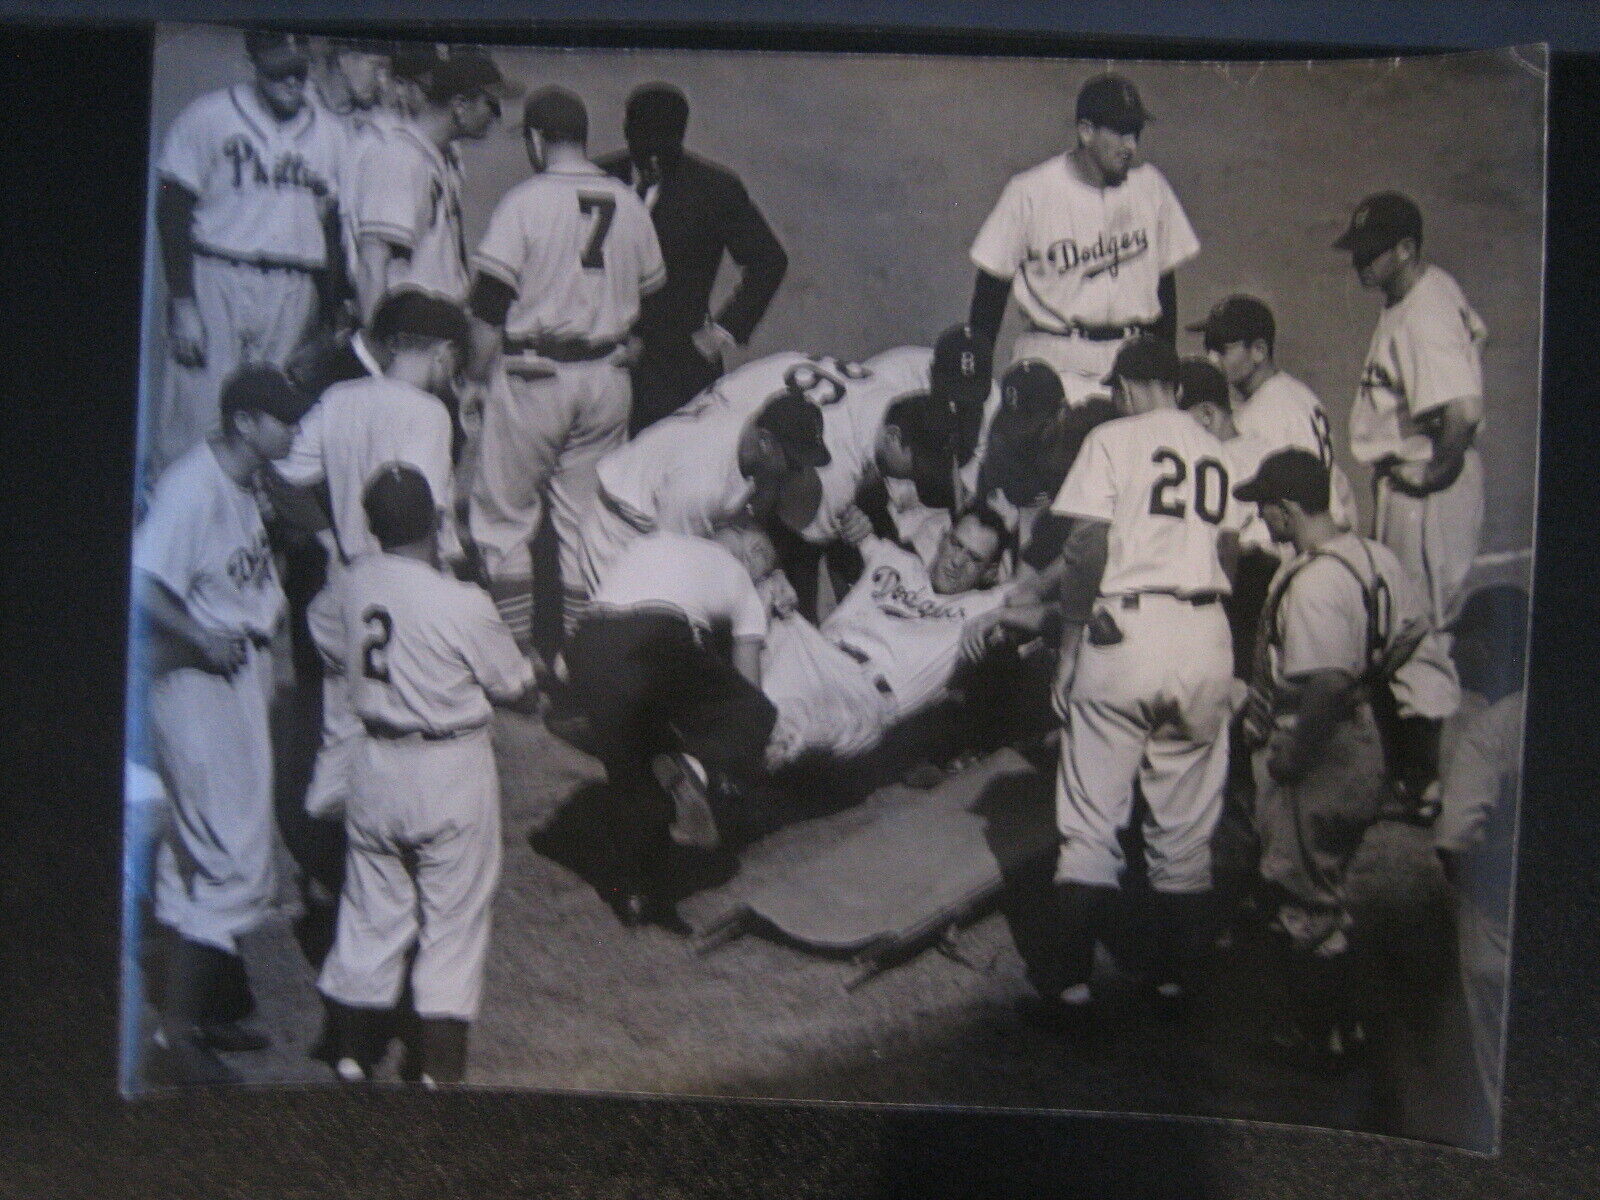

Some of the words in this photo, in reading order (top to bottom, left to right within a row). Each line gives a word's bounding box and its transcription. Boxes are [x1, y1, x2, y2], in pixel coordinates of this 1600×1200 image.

[577, 190, 616, 268] 7
[1047, 228, 1148, 280] Dodgers
[1148, 448, 1229, 526] 20
[363, 604, 392, 681] 2
